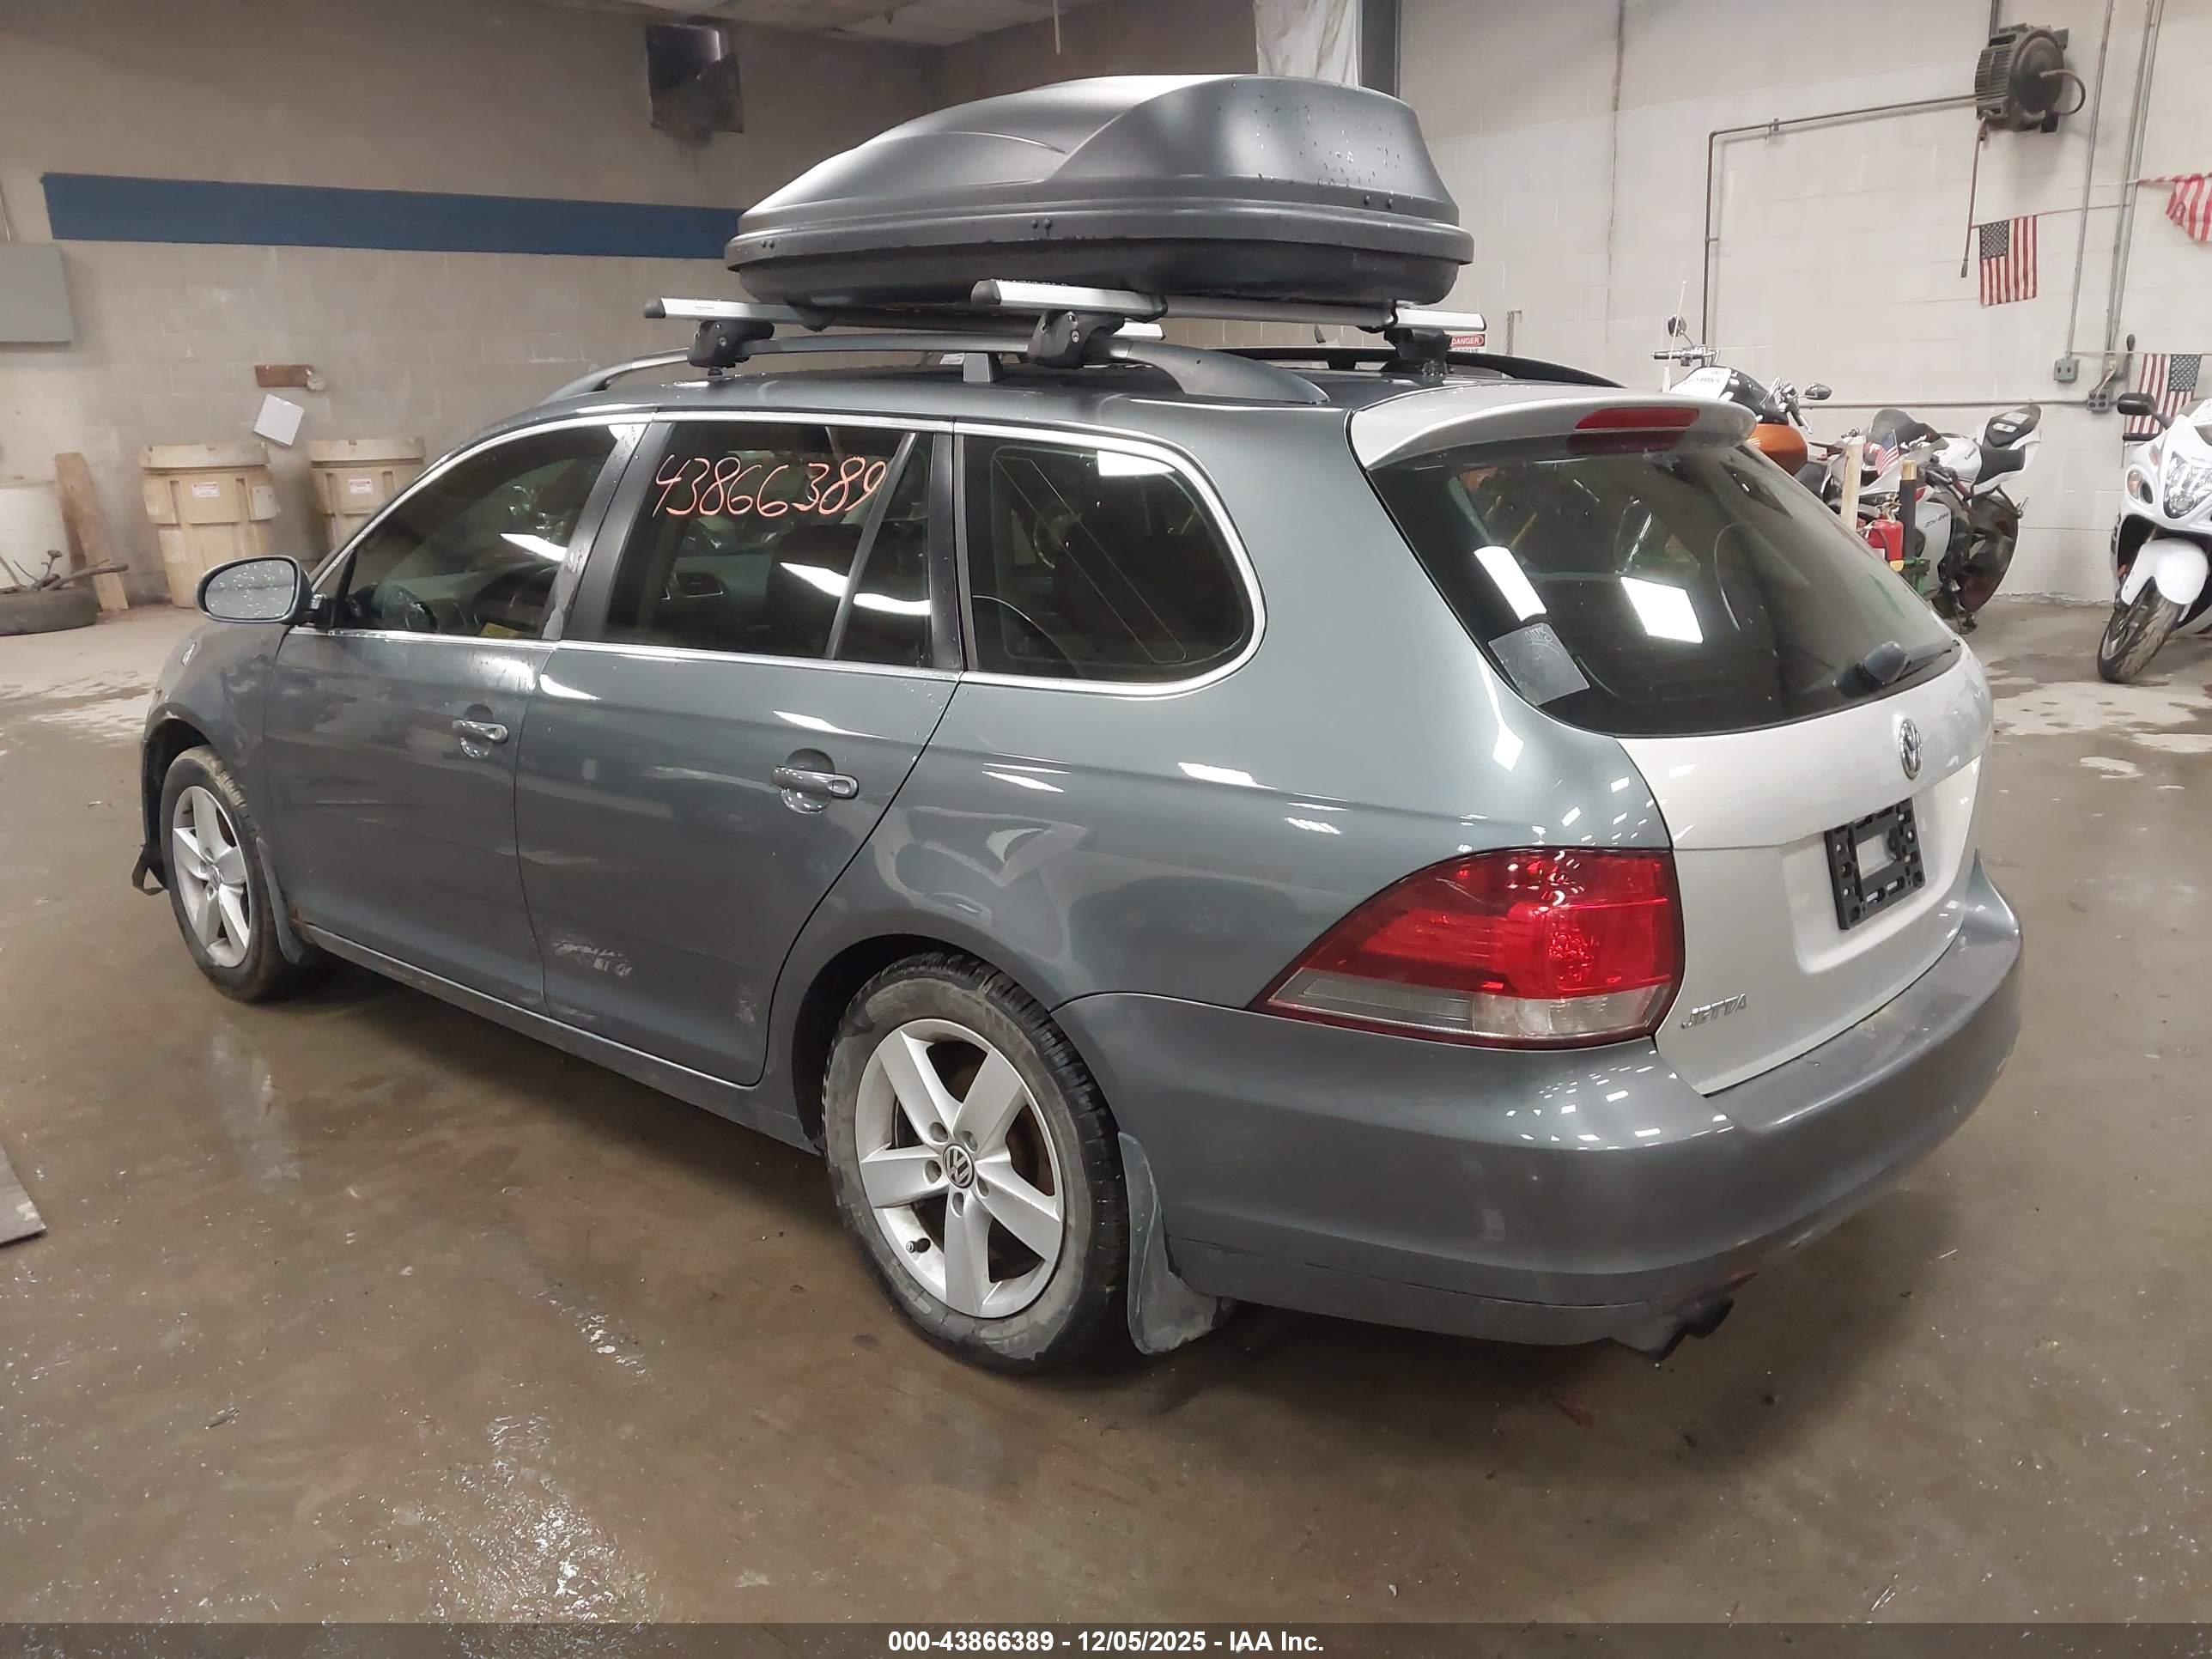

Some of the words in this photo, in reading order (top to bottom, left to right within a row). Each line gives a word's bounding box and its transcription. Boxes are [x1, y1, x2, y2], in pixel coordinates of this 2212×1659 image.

[1451, 336, 1480, 345] DANGER
[653, 454, 887, 517] 43866389
[1681, 993, 1747, 1029] JETTA
